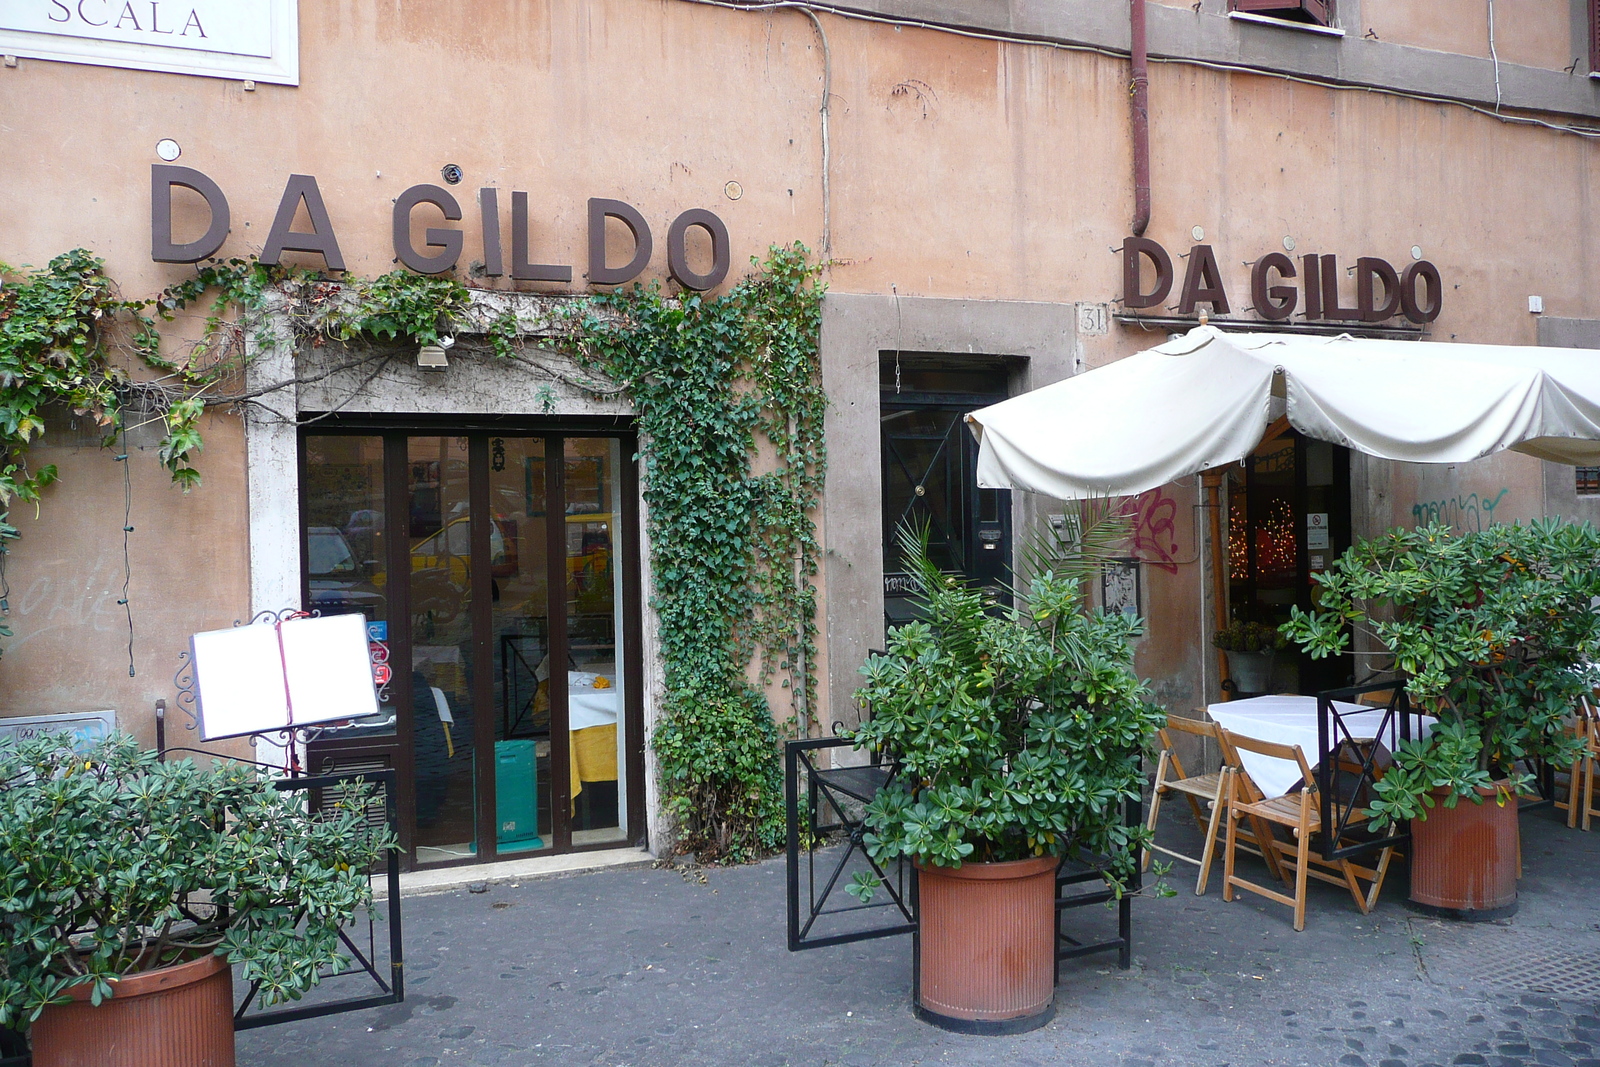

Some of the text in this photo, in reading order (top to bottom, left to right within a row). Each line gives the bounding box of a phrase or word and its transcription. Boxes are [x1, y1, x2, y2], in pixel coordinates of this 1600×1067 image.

[48, 0, 208, 39] SCALA
[151, 163, 730, 291] DA GILDO
[1123, 236, 1443, 325] DA GILDO
[1083, 308, 1102, 331] 31
